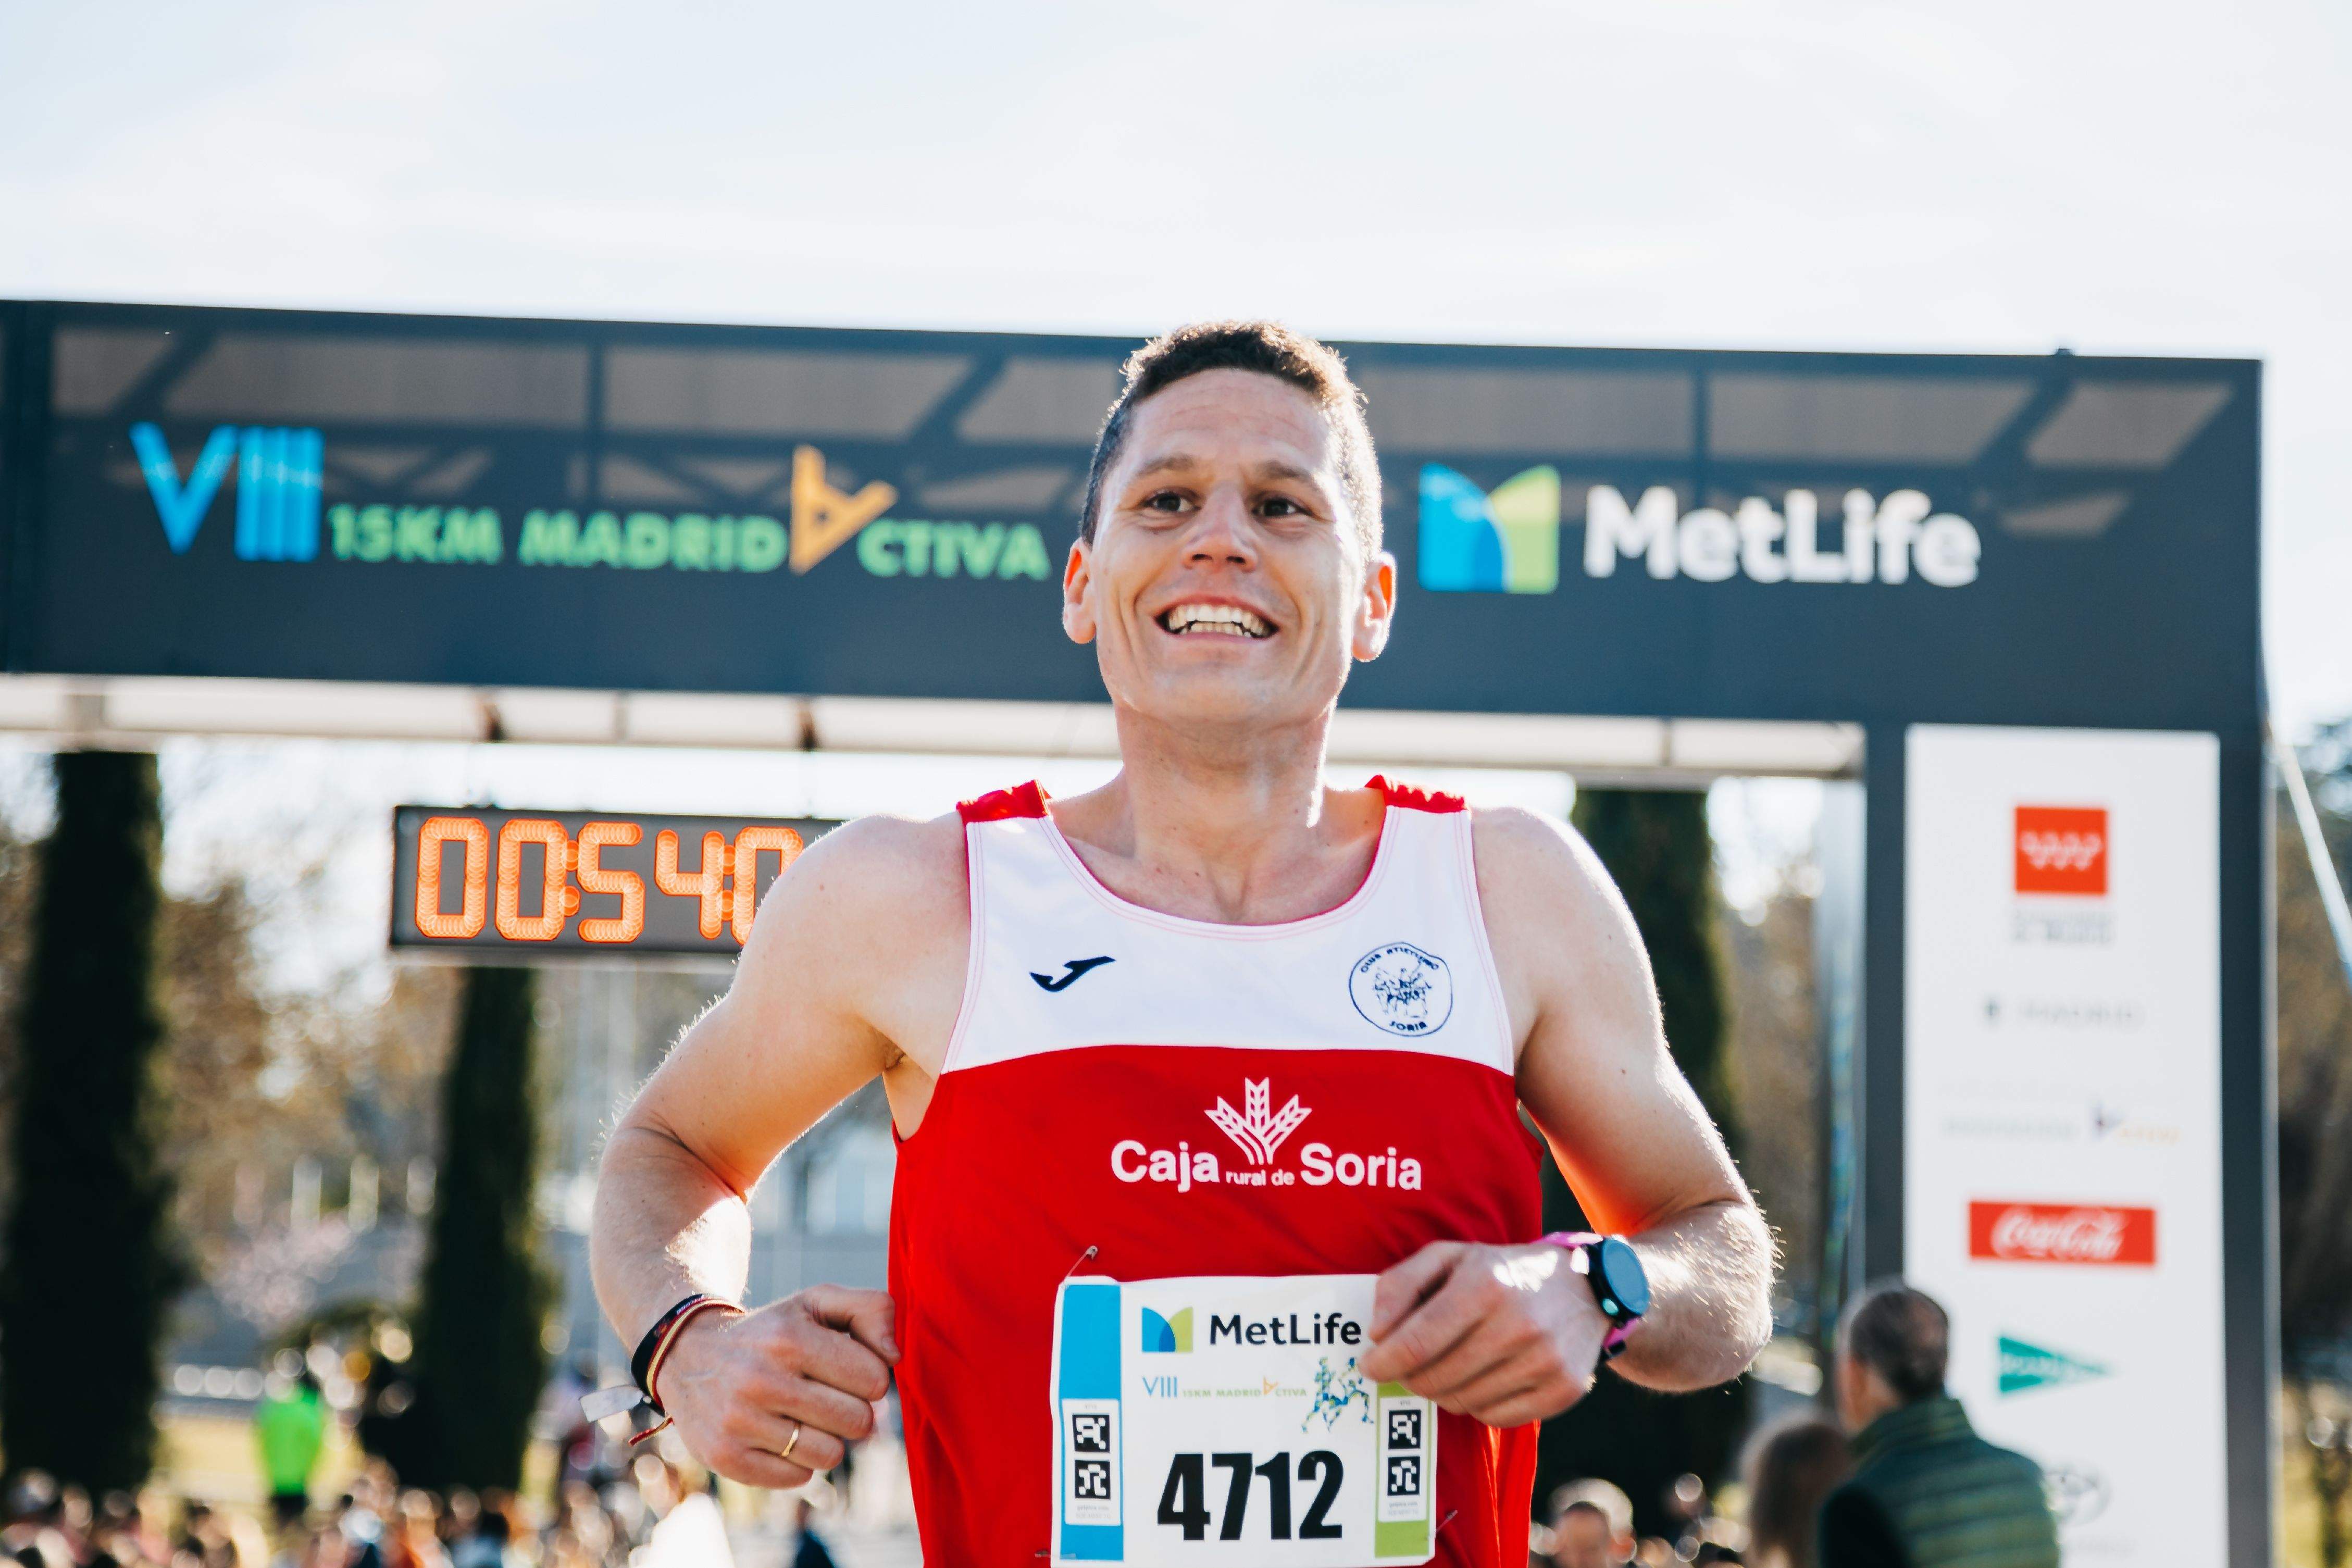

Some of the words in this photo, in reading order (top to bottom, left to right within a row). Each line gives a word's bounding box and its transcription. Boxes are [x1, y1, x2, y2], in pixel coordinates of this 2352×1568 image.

[129, 421, 325, 562] VIII
[327, 504, 503, 564] 15KM
[517, 508, 788, 574] MADRID
[1583, 484, 1982, 587] MetLife
[1390, 1021, 1427, 1031] SORIA
[1111, 1140, 1220, 1193] Caja
[1226, 1169, 1266, 1186] rural
[1271, 1168, 1295, 1186] de
[1300, 1142, 1422, 1190] Soria
[1210, 1312, 1362, 1345] MetLife
[1142, 1376, 1178, 1398] VIII
[1216, 1389, 1261, 1397] MADRID
[1158, 1450, 1345, 1541] 4712
